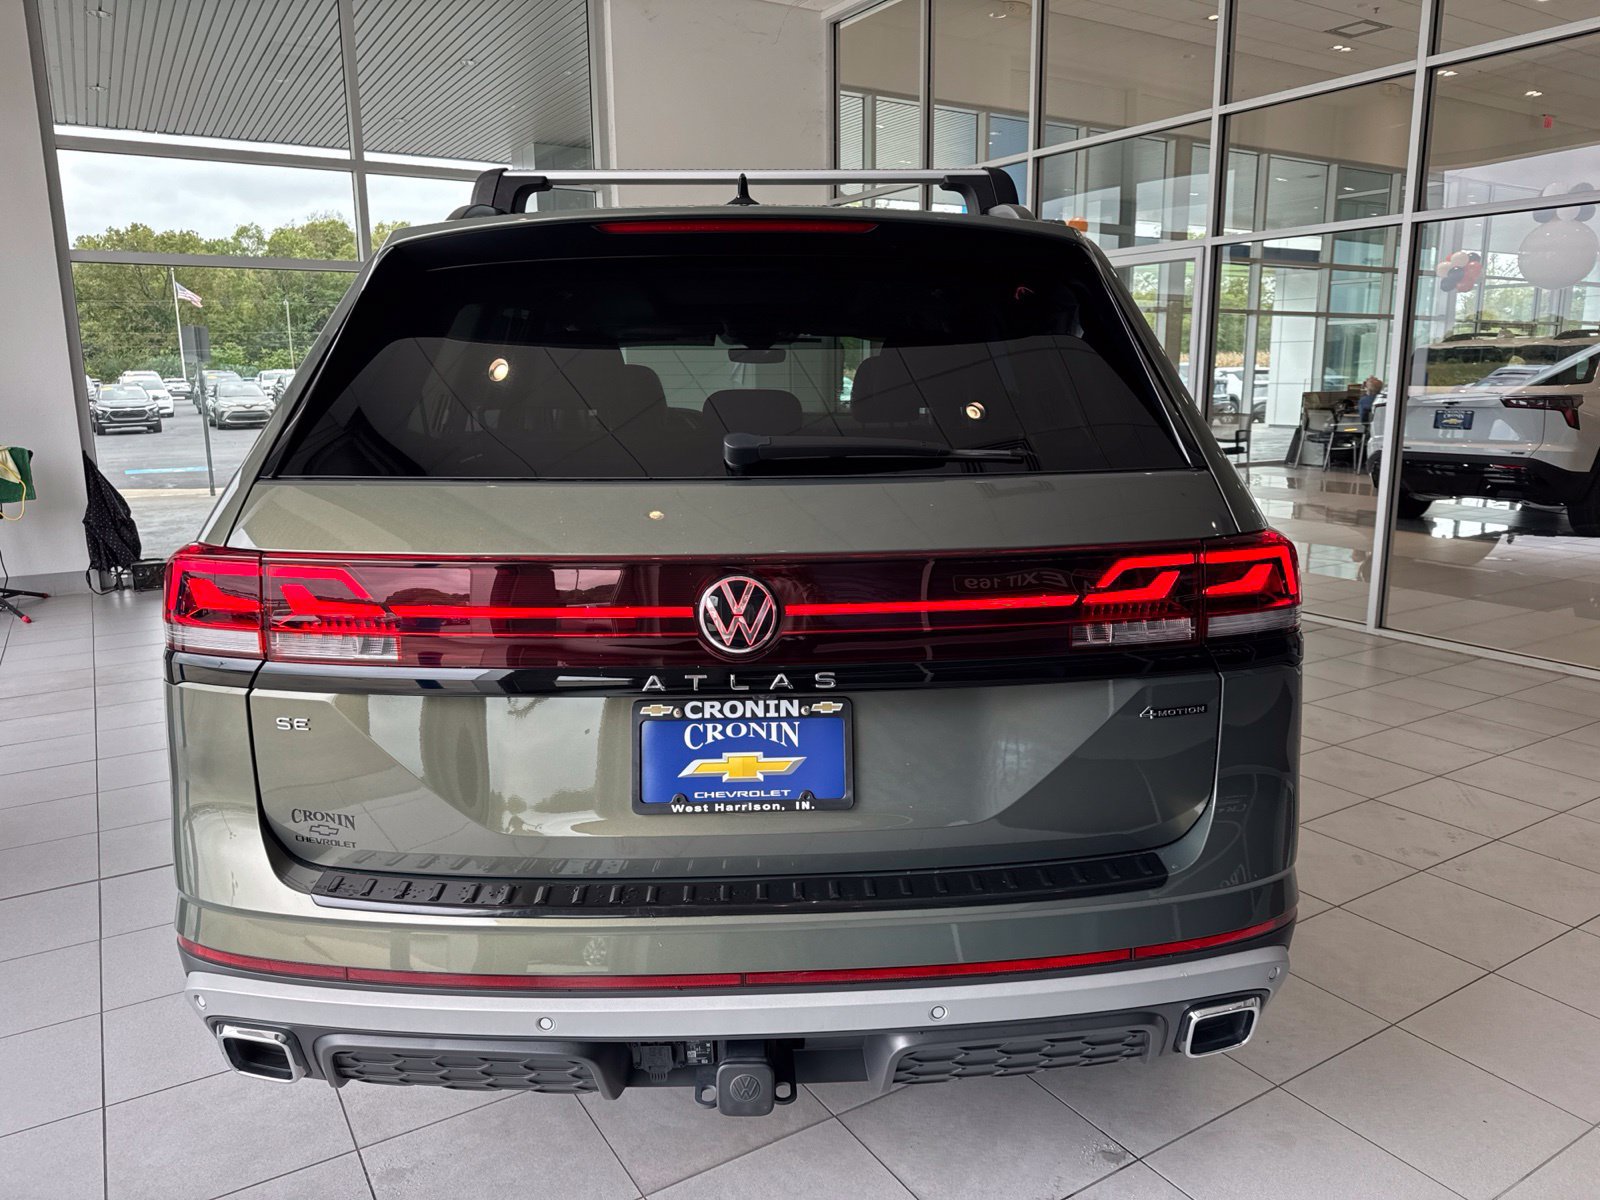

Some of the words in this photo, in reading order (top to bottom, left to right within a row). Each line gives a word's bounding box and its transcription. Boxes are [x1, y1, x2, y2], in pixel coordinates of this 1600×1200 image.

[642, 672, 836, 692] ATLAS
[685, 700, 800, 720] CRONIN
[1139, 705, 1205, 720] 4MOTION
[276, 717, 311, 731] SE
[684, 722, 800, 750] CRONIN
[694, 789, 792, 799] CHEVROLET
[671, 803, 708, 813] West
[714, 802, 785, 813] Harrison,
[796, 801, 815, 811] IN.
[291, 808, 356, 831] CRONIN
[295, 835, 357, 848] CHEVROLET
